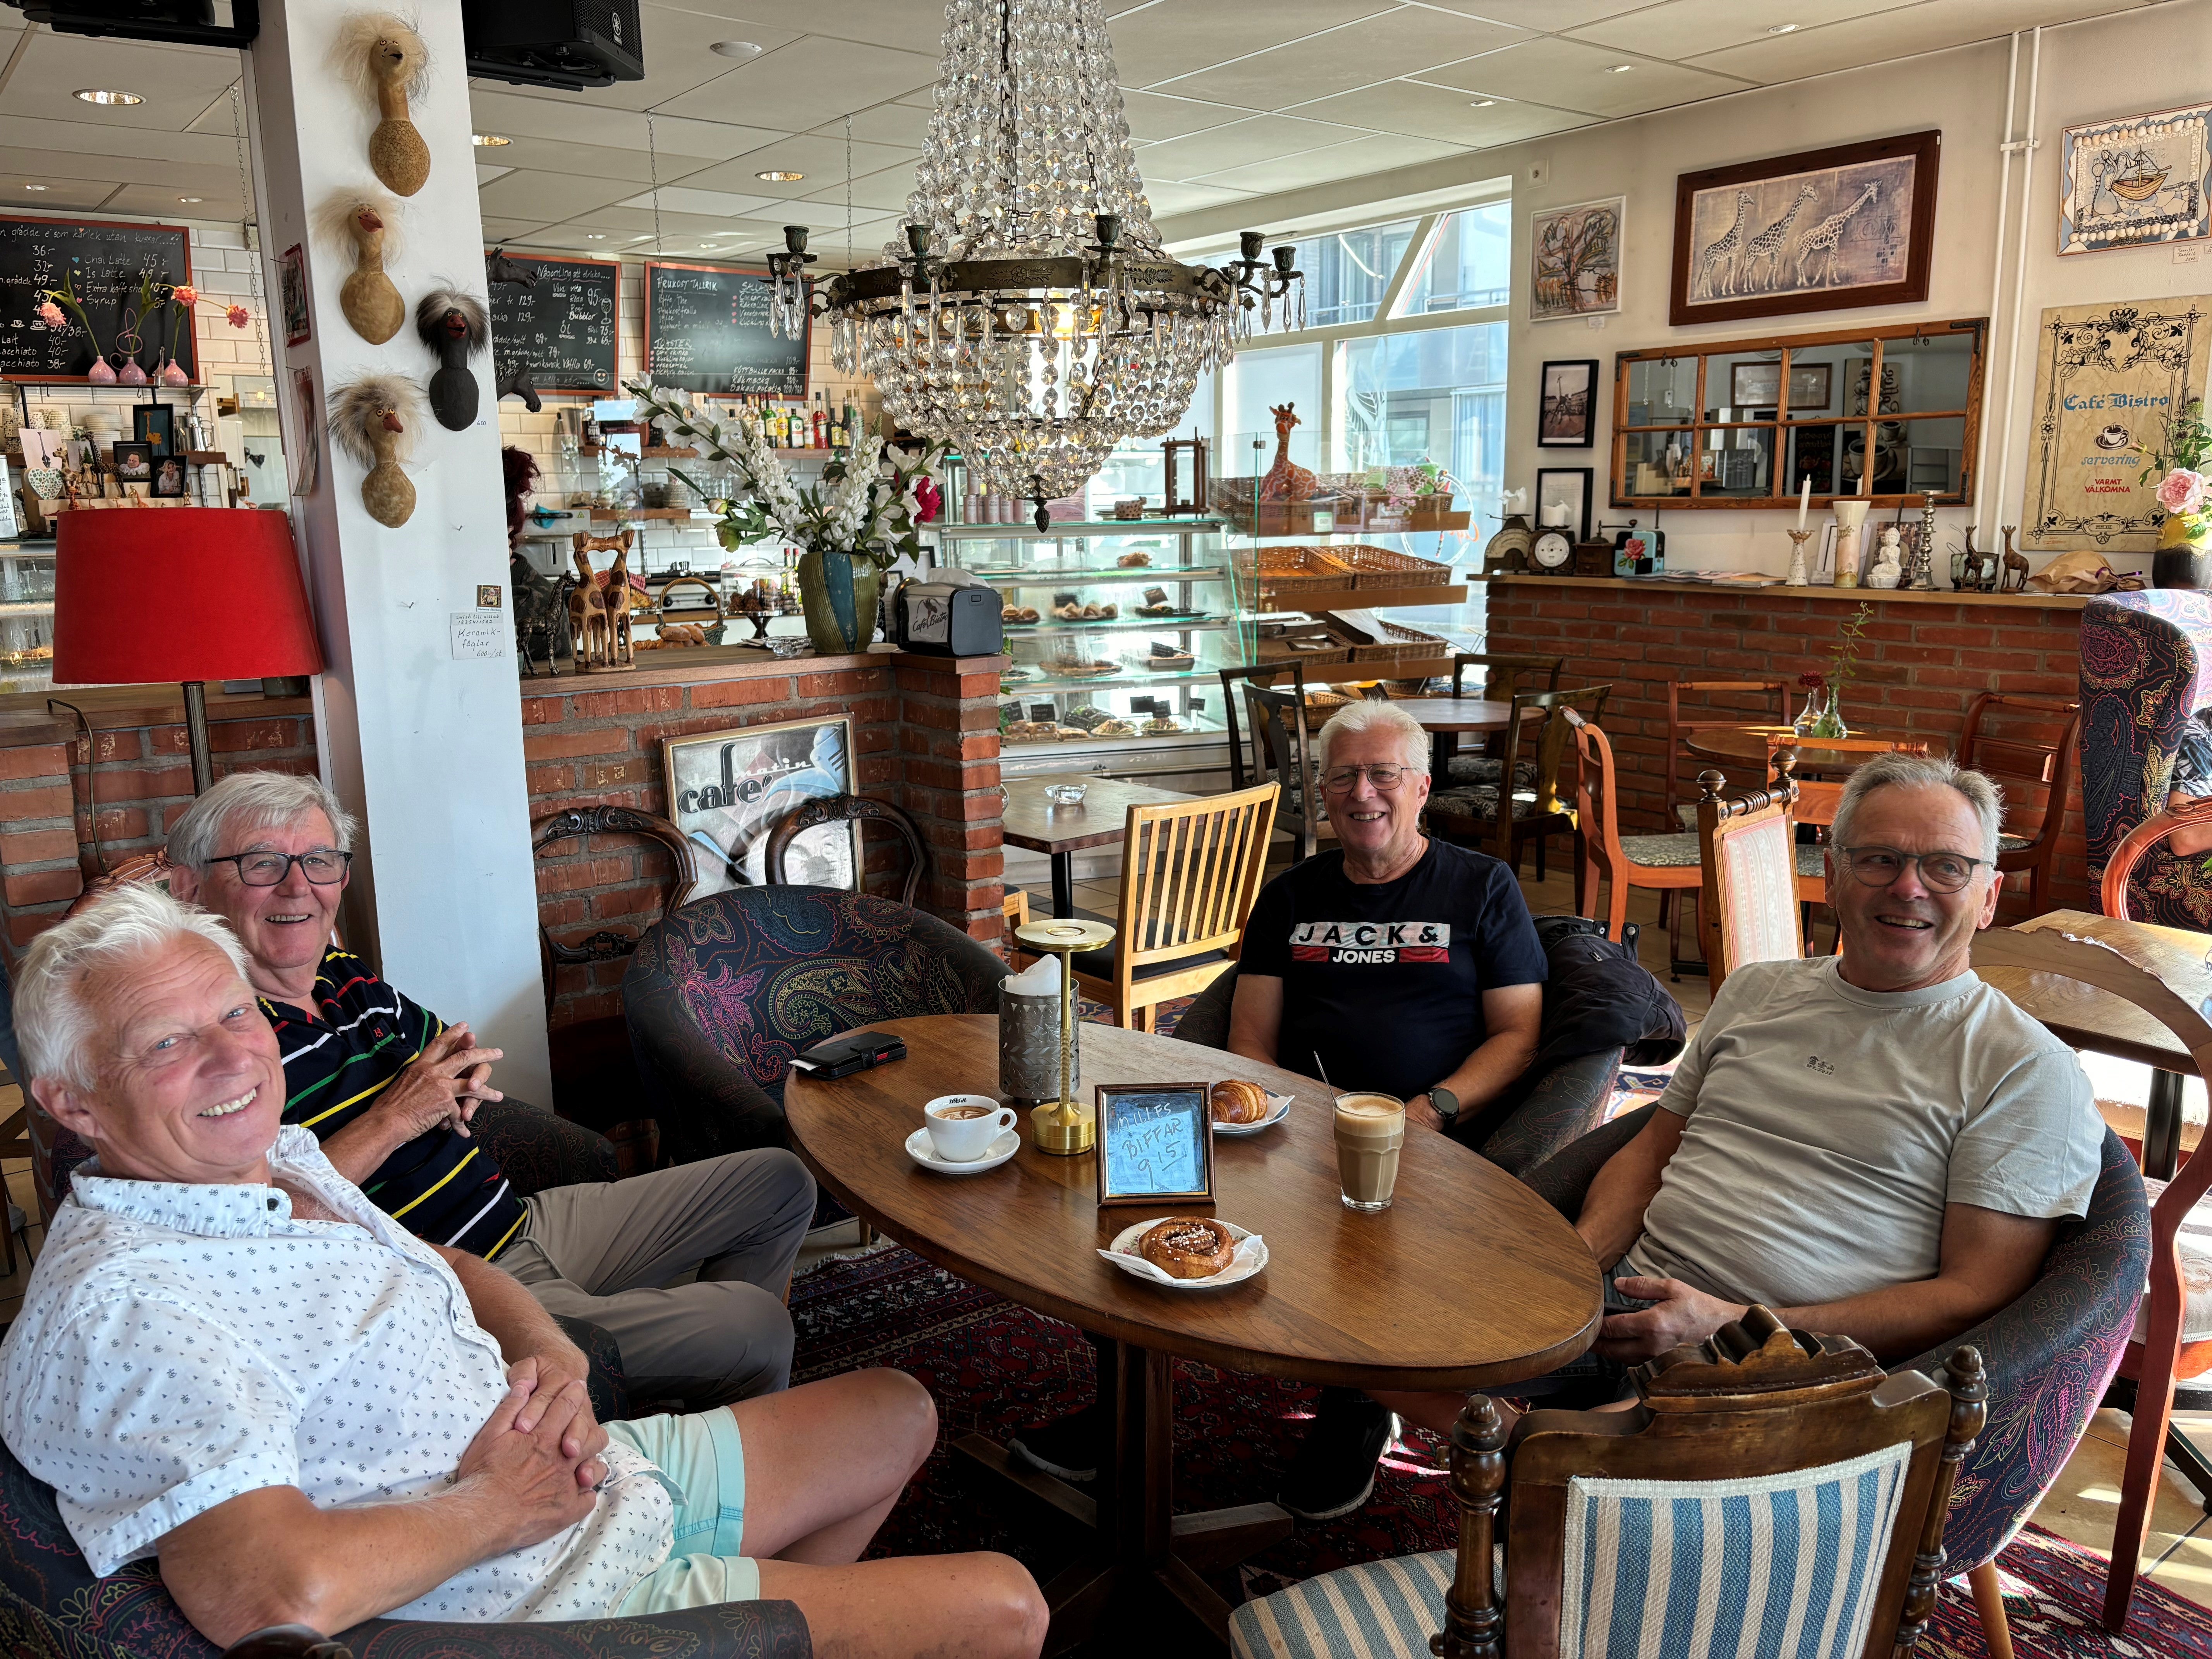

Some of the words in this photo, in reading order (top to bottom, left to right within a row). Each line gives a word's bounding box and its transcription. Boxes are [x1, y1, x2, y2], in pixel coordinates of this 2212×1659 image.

[85, 254, 105, 265] Chai
[101, 267, 126, 278] Latte
[87, 282, 107, 293] Extra
[553, 282, 566, 292] Vin
[87, 294, 117, 310] Syrup
[2, 333, 19, 345] Lait
[0, 346, 37, 356] acchiato
[0, 358, 39, 368] acchiato
[2064, 393, 2106, 410] Café
[2107, 391, 2169, 412] Bistro
[2081, 454, 2140, 469] servering
[2085, 484, 2130, 493] VÄLKOMNA
[913, 618, 928, 633] Café
[1298, 924, 1407, 946] JACK
[1419, 925, 1439, 943] &
[1332, 950, 1395, 964] JONES
[1121, 1118, 1183, 1160] BIFFAR
